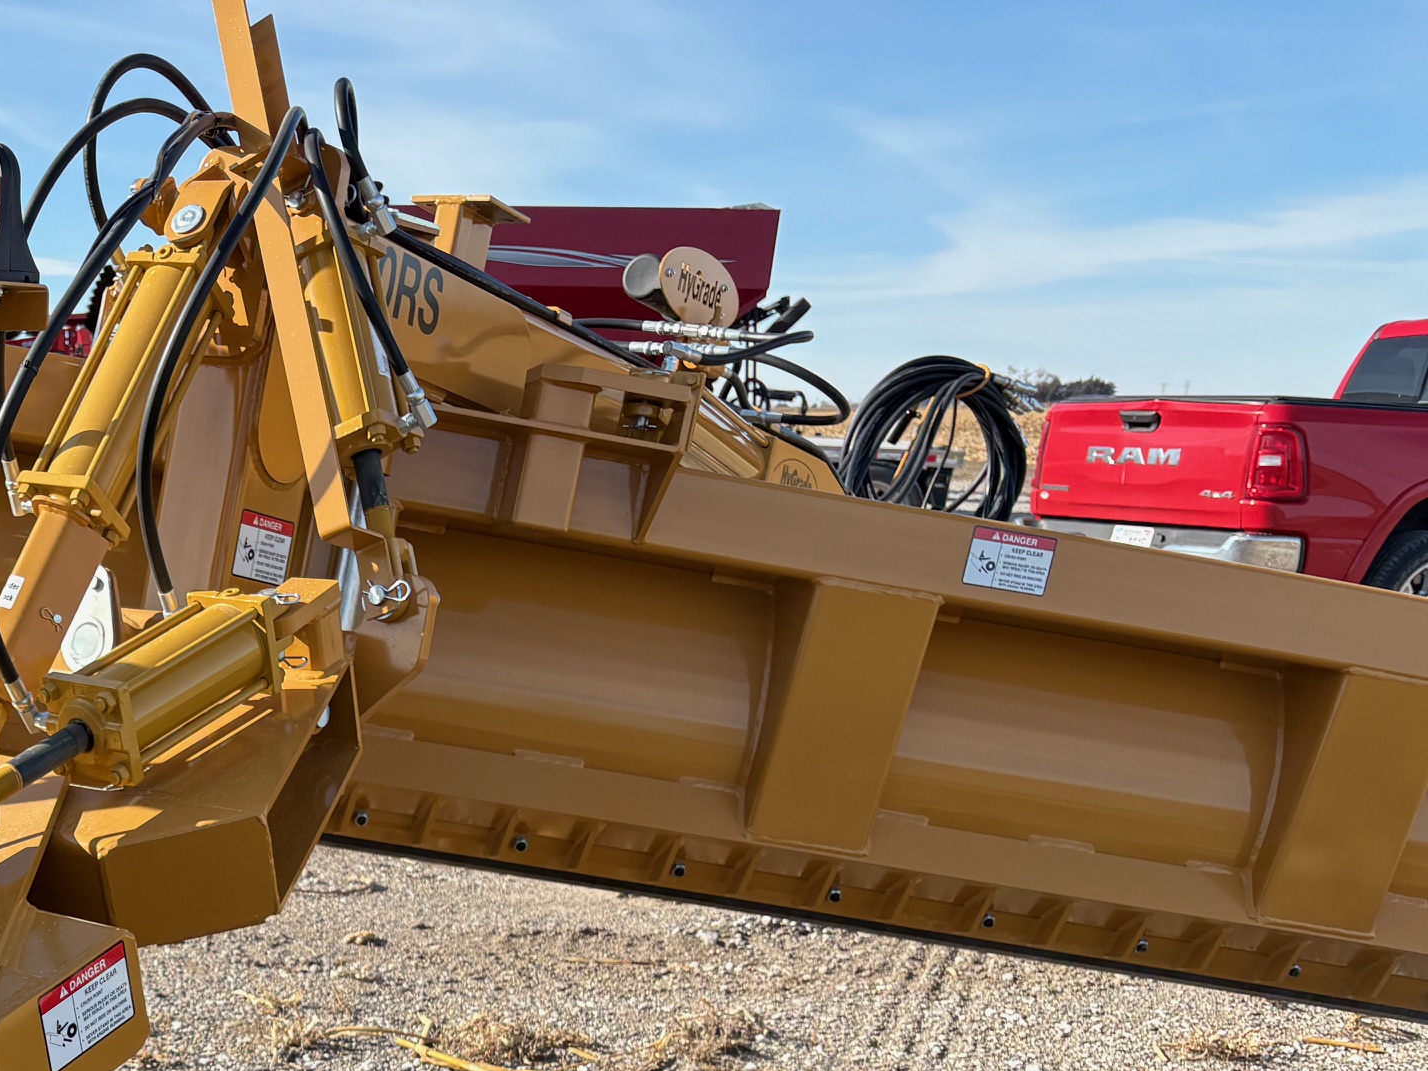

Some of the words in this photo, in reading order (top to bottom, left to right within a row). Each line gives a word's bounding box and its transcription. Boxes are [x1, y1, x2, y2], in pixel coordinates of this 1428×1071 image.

[677, 261, 723, 309] HyGrade
[1086, 446, 1182, 466] RAM
[260, 519, 283, 532] DANGER
[1002, 534, 1039, 547] DANGER
[69, 959, 107, 992] DANGER
[84, 982, 99, 996] KEEP
[99, 969, 117, 986] CLEAR
